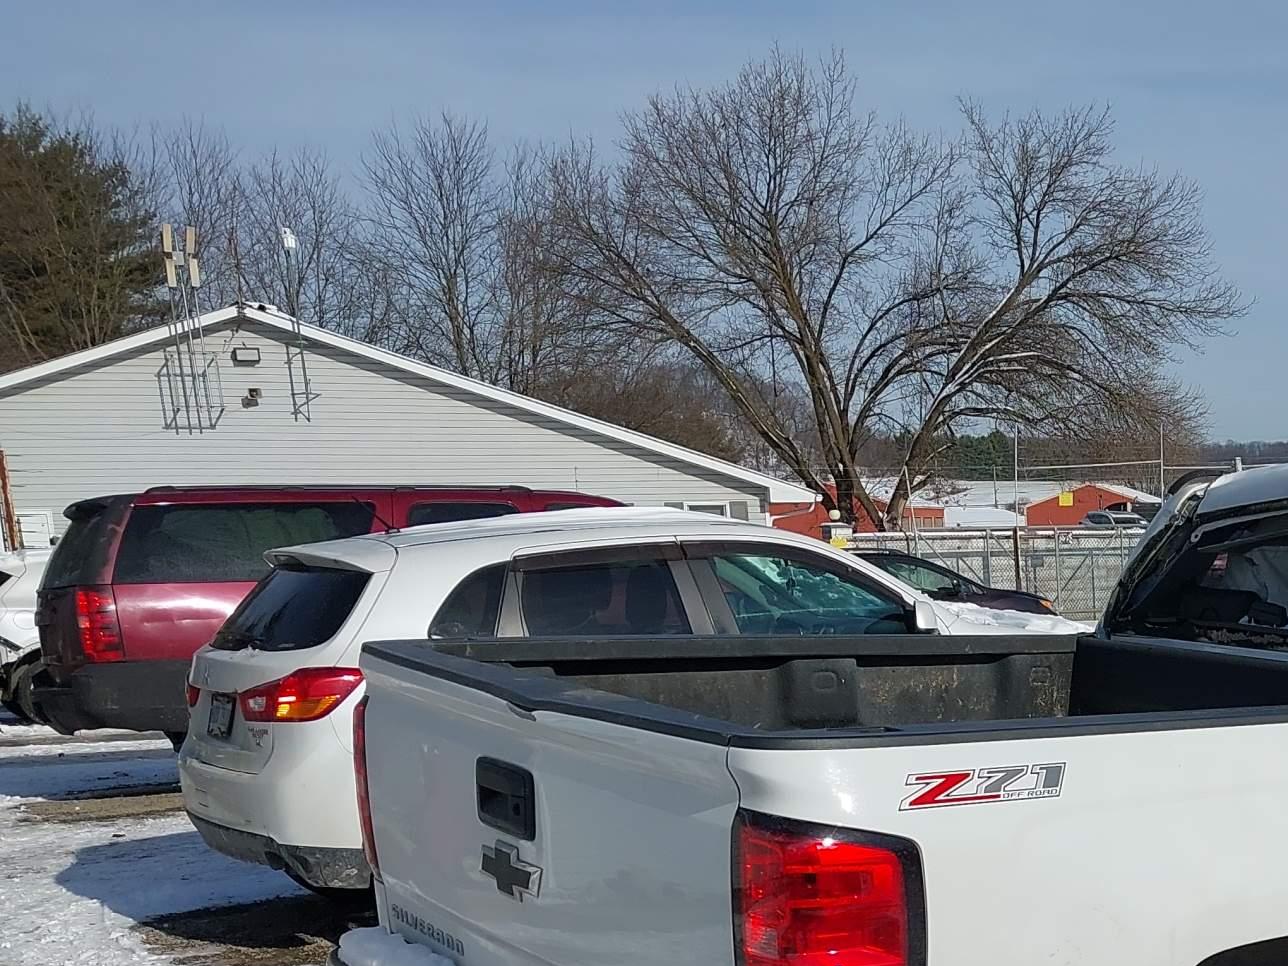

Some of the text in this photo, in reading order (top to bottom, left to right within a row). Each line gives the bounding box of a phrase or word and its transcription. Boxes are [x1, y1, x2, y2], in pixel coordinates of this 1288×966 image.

[899, 763, 1066, 811] Z71
[1003, 788, 1058, 799] OFF ROAD
[391, 903, 465, 956] SILVERADO
